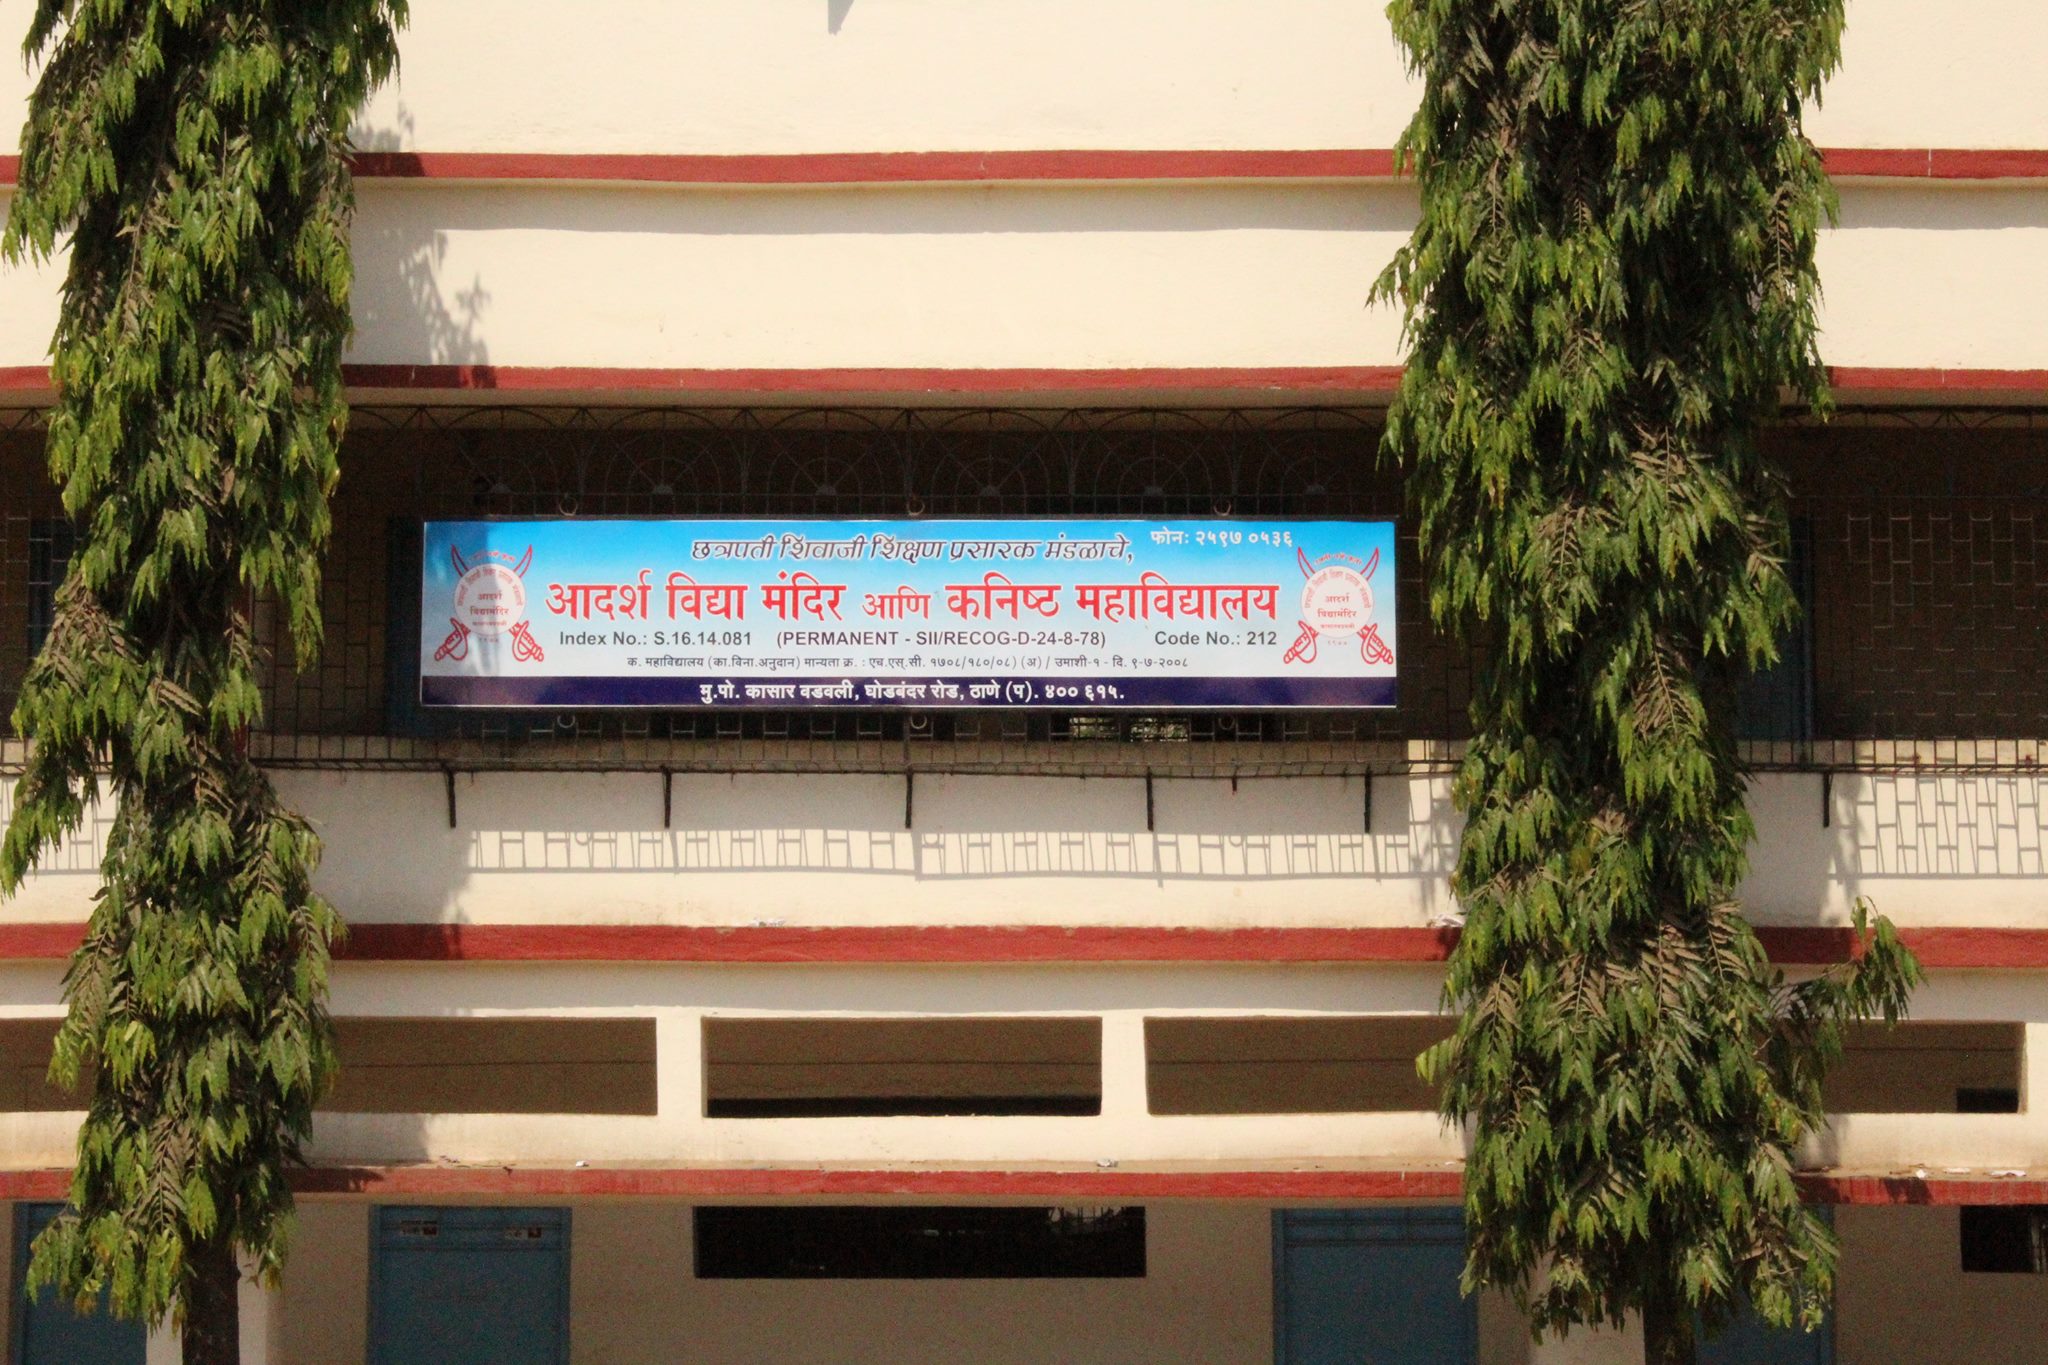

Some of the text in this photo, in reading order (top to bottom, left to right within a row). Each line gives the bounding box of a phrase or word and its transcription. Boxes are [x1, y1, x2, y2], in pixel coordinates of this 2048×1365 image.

[692, 535, 776, 559] छत्रपती
[780, 533, 868, 560] शिवाजी
[871, 533, 946, 564] शिक्षण
[950, 540, 1042, 561] प्रसारक
[546, 569, 651, 620] आदर्श
[665, 571, 748, 621] विद्या
[761, 570, 847, 621] मंदिर
[862, 586, 931, 620] आणि
[945, 571, 1061, 621] कनिष्ठ
[1075, 571, 1279, 623] महाविद्यालय
[560, 631, 606, 645] Index
[613, 631, 647, 645] No.:
[654, 631, 750, 646] S.16.14.081
[777, 631, 898, 649] (PERMANENT
[1155, 631, 1277, 646] Code No.: 212
[645, 655, 704, 668] महाविद्यालय
[804, 657, 840, 668] मान्यता
[700, 680, 740, 703] मु.पो.
[745, 684, 795, 699] कासार
[800, 679, 860, 701] वडवली,
[864, 680, 926, 699] घोडबंदर
[930, 680, 964, 701] रोड,
[969, 680, 1000, 699] ठाणे
[1045, 685, 1078, 699] ४००
